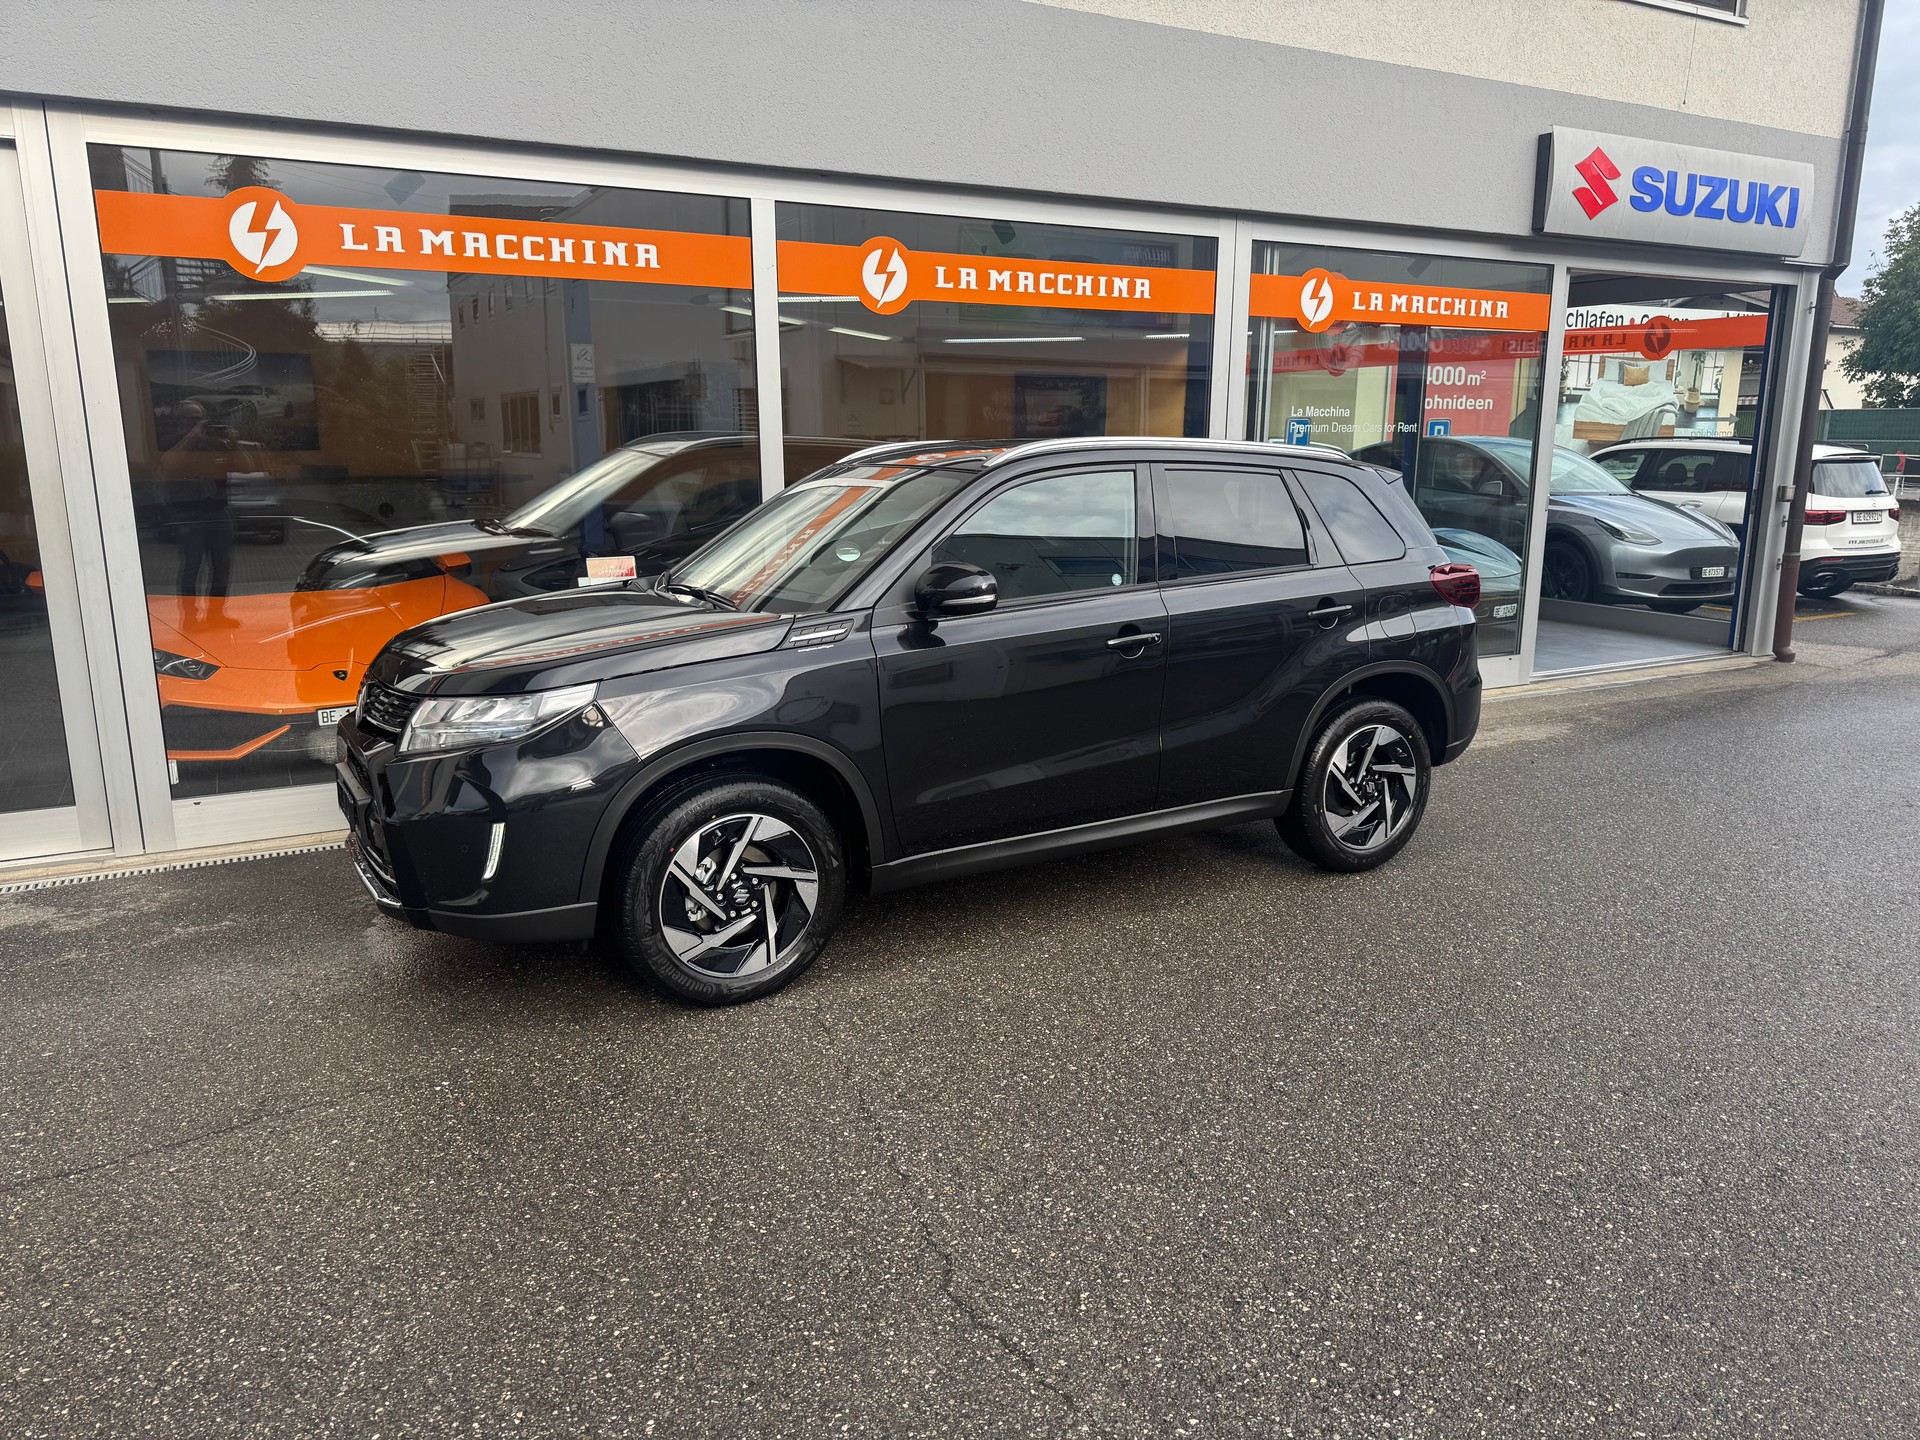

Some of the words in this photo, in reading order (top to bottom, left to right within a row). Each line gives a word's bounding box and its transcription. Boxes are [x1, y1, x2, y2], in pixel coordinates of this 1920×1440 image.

[1630, 166, 1800, 228] SUZUKI
[339, 223, 406, 253] LA
[418, 228, 661, 269] MACCHINA
[935, 265, 979, 290] LA
[987, 269, 1152, 299] MACCHINA
[1352, 291, 1384, 311] LA
[1389, 293, 1509, 319] MACCHINA
[1566, 309, 1625, 328] chlafen
[1291, 405, 1302, 417] La
[1305, 405, 1351, 417] Macchina
[1425, 394, 1494, 410] ohnideen
[1290, 421, 1330, 433] Premium
[1331, 421, 1360, 433] Dream
[1362, 421, 1383, 433] Cars
[1385, 421, 1396, 433] for
[1397, 421, 1418, 433] Rent
[321, 709, 338, 724] BE
